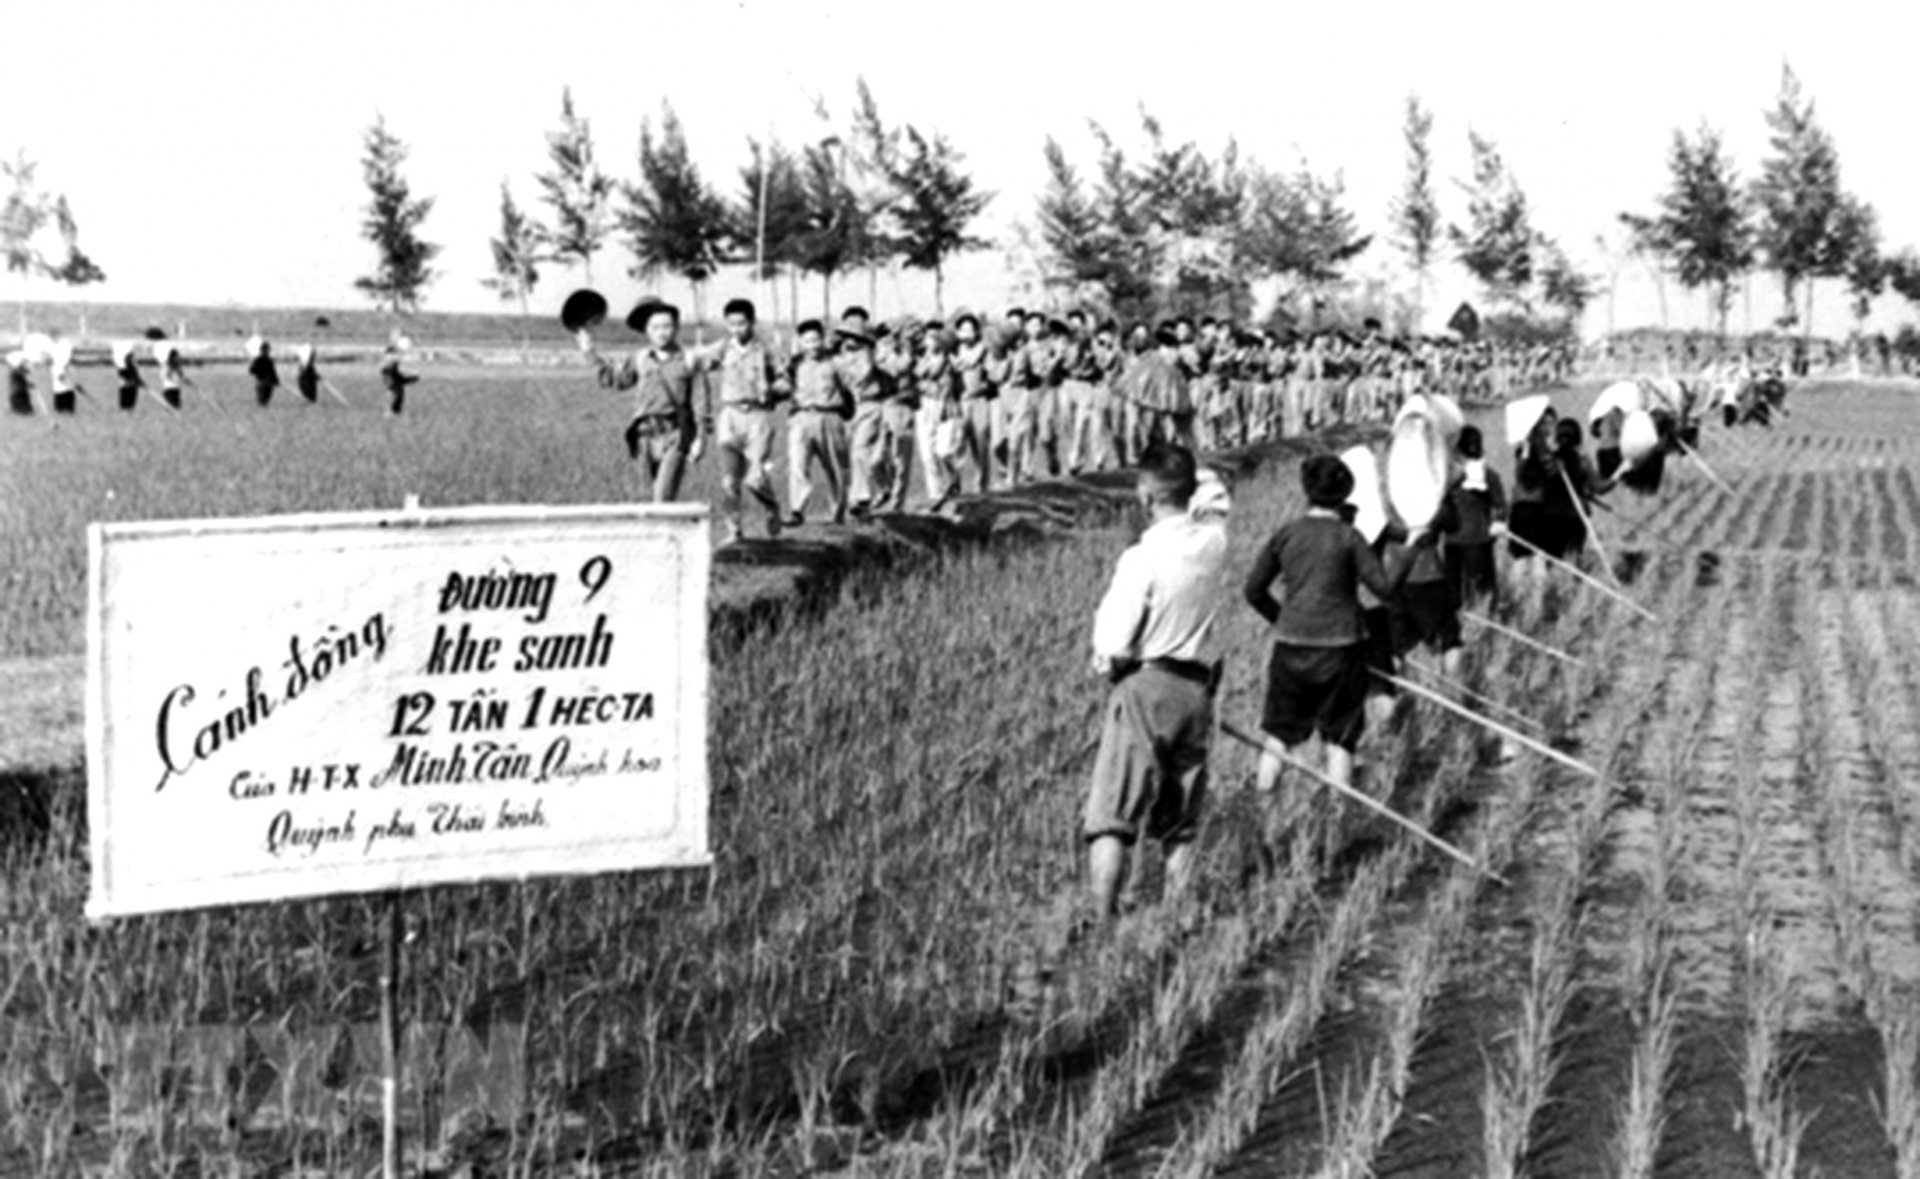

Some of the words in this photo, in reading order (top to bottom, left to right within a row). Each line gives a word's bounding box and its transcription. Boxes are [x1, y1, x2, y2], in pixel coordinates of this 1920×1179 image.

[578, 554, 613, 604] 9
[424, 622, 502, 675] khe
[514, 613, 615, 672] sanh
[388, 690, 436, 737] 12
[447, 687, 509, 733] TẤN
[519, 686, 546, 730] 1
[369, 741, 466, 788] Minh
